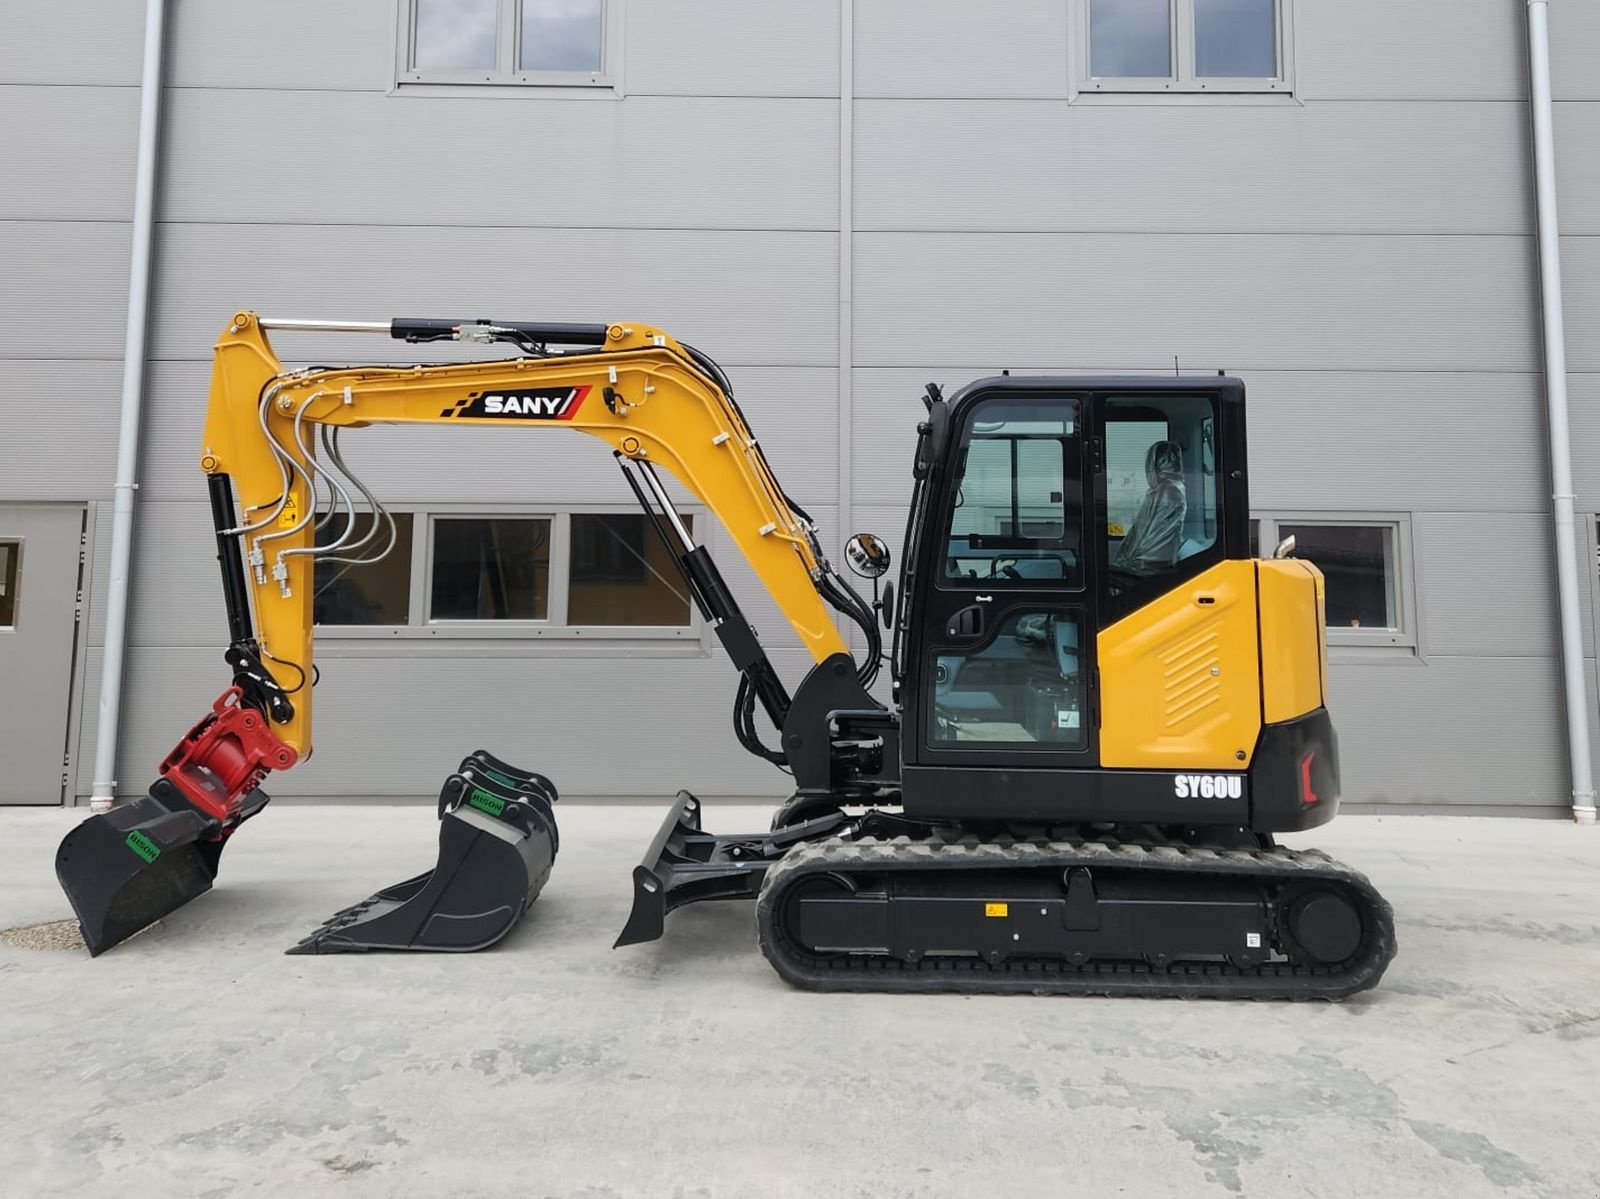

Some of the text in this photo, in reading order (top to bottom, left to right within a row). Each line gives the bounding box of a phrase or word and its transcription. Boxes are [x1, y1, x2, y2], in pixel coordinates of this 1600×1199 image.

[484, 396, 562, 414] SANY
[1174, 774, 1242, 799] SY60U
[472, 793, 503, 811] BISON
[129, 833, 158, 859] BISON
